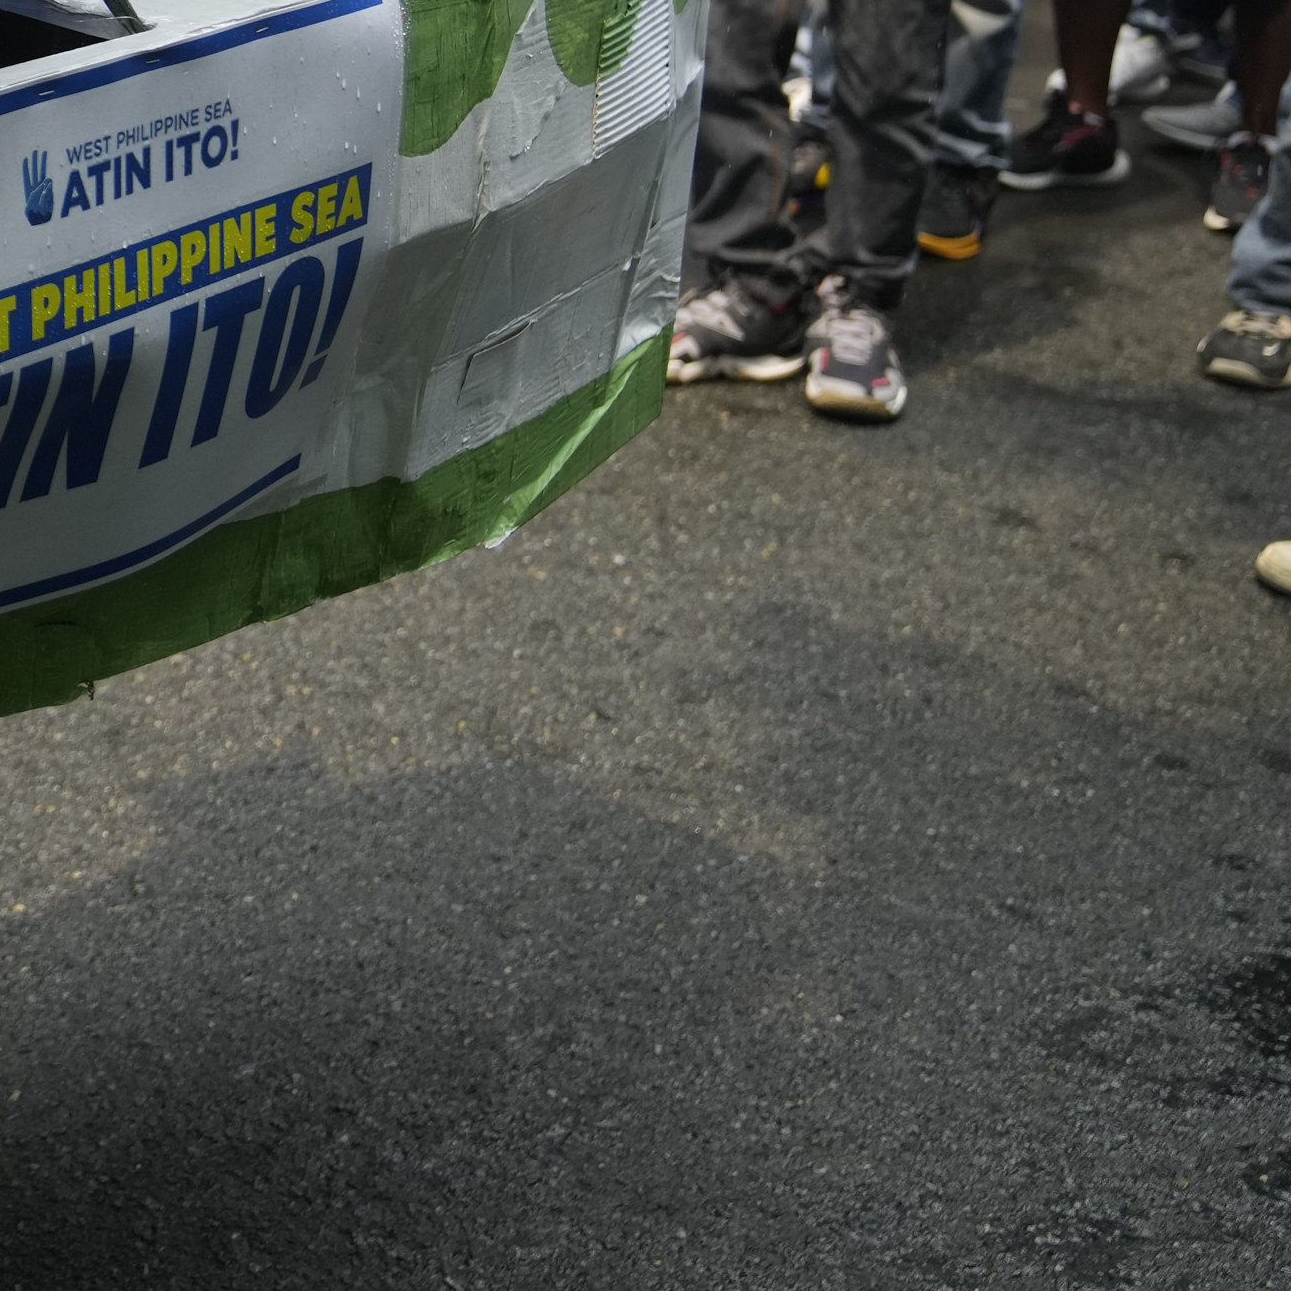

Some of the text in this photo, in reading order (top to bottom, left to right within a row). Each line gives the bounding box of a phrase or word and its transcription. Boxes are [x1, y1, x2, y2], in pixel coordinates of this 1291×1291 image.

[60, 119, 240, 218] ATIN ITO!
[65, 99, 233, 165] WEST PHILIPPINE SEA
[30, 206, 278, 342] PHILIPPINE
[289, 175, 365, 245] SEA
[137, 236, 365, 470] ITO!
